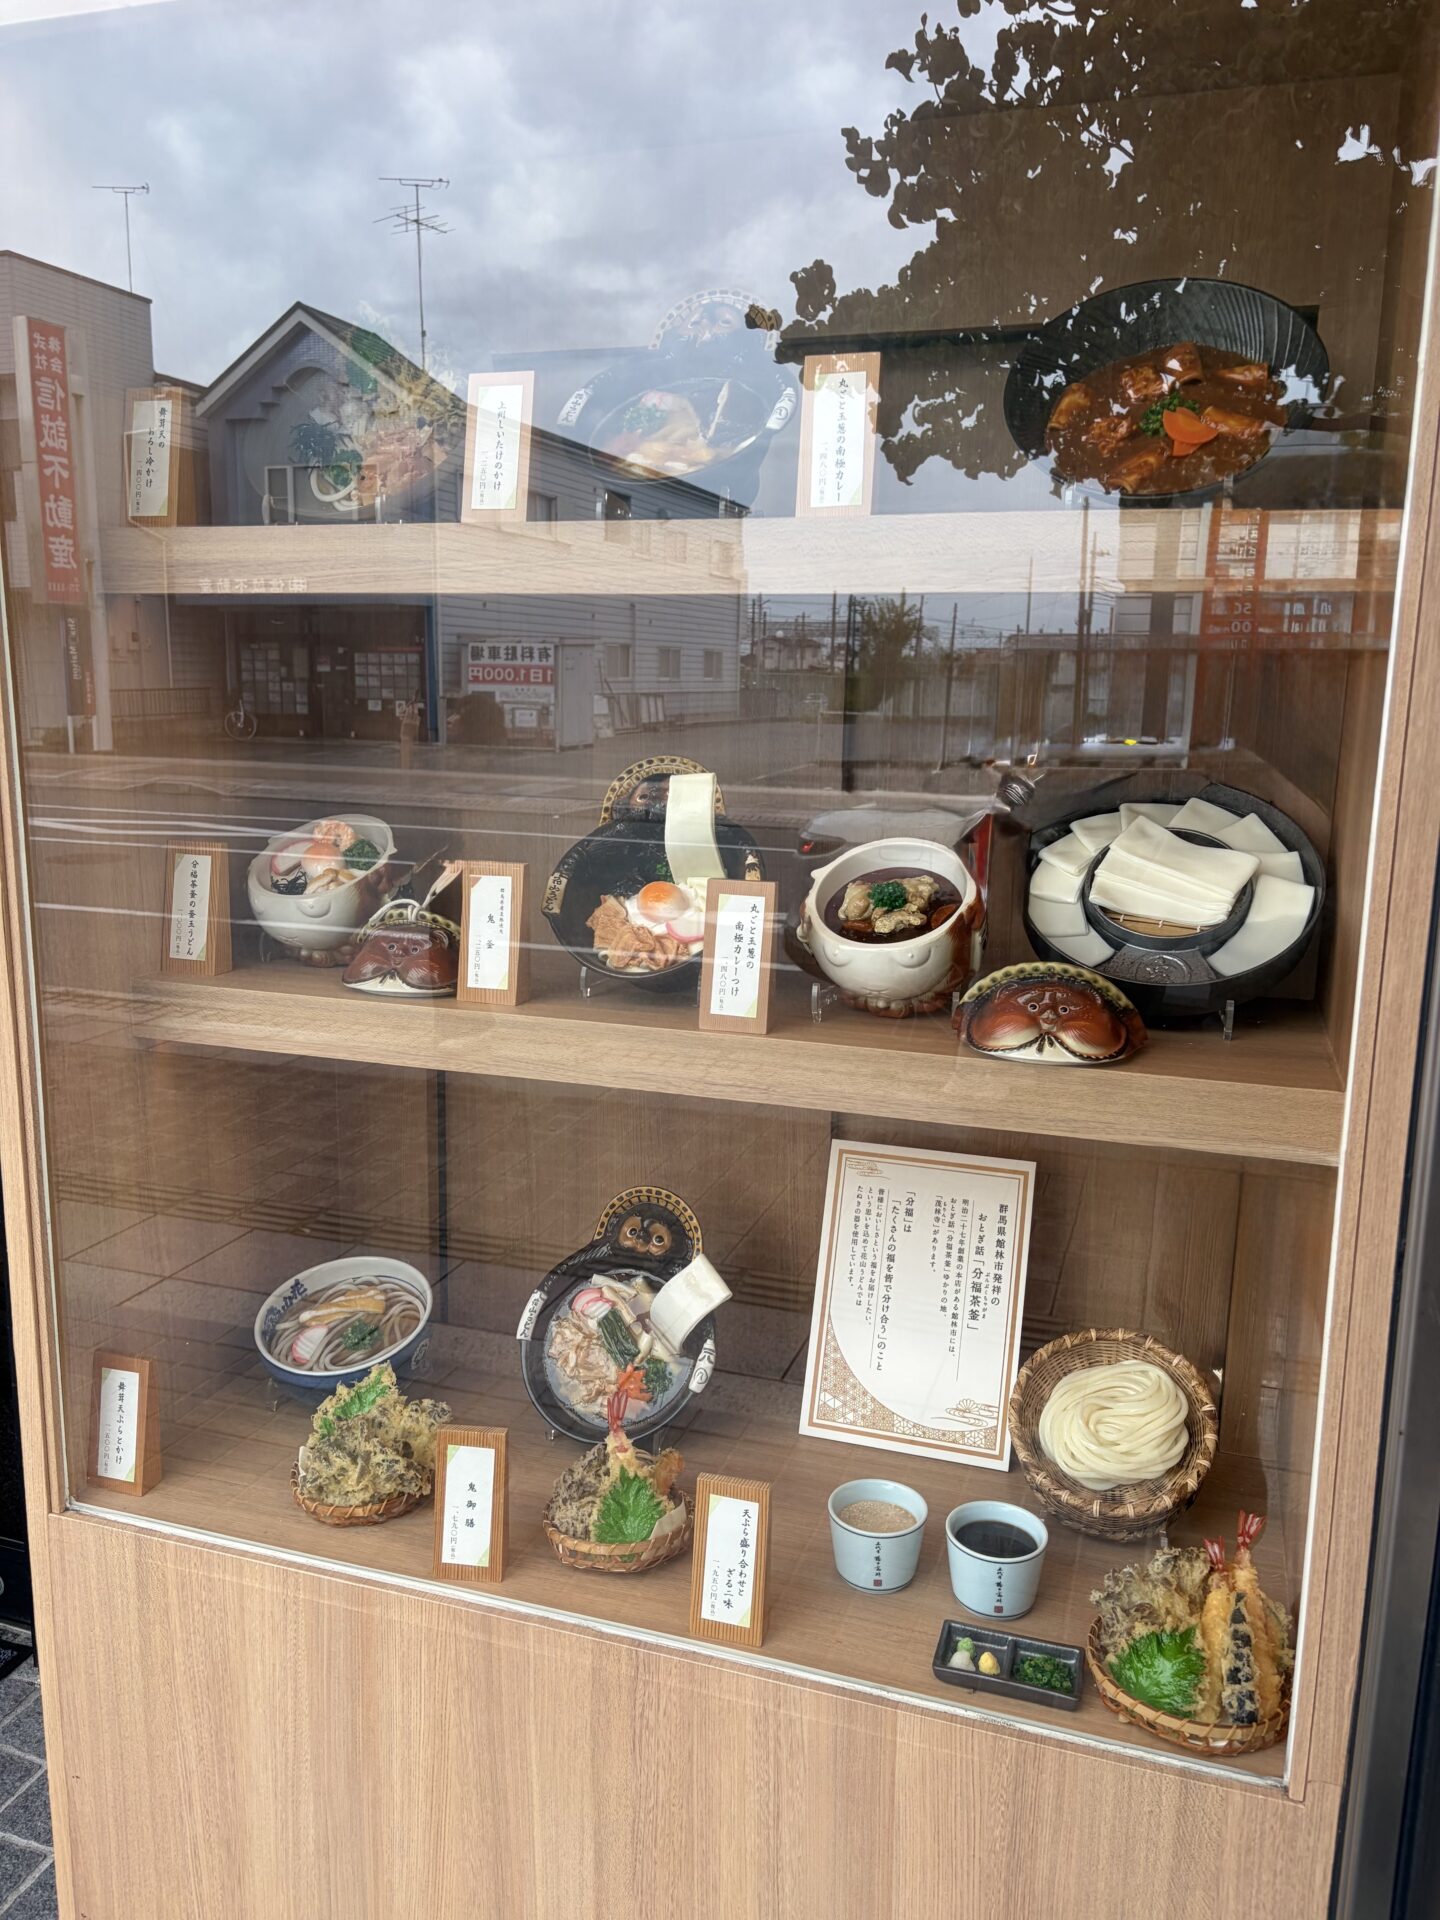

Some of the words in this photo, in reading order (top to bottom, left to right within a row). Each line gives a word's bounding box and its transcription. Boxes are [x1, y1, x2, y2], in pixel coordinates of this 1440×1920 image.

[903, 1191, 916, 1233] 「分福」は
[991, 1204, 1008, 1306] 群馬県館林市発祥の
[967, 1213, 987, 1330] おとぎ話「分福茶釜」
[737, 1509, 752, 1597] 天ぷら盛り合わせと
